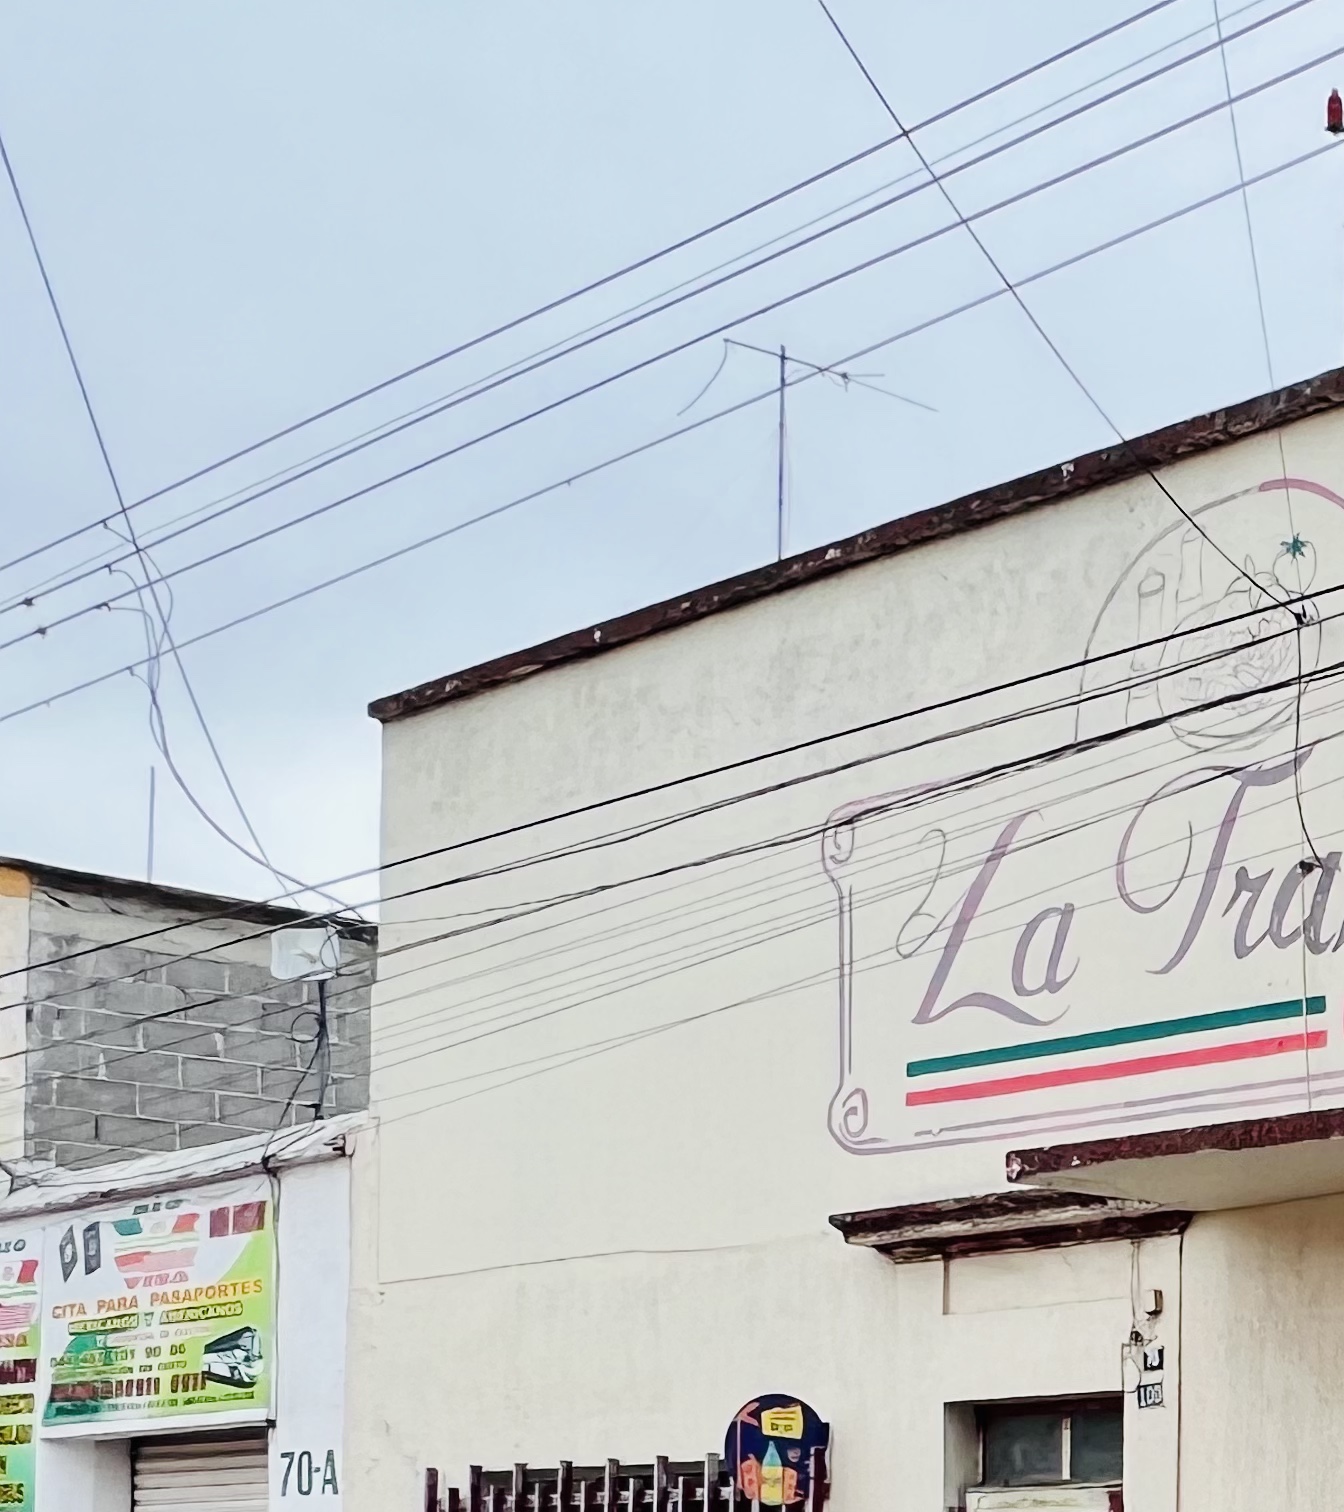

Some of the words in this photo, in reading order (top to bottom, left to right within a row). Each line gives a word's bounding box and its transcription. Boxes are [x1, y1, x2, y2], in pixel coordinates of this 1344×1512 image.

[896, 808, 1080, 1026] La
[52, 1303, 87, 1319] CITA
[97, 1295, 139, 1315] PARA
[150, 1279, 263, 1306] PASAPORTES
[280, 1449, 339, 1497] 70-A
